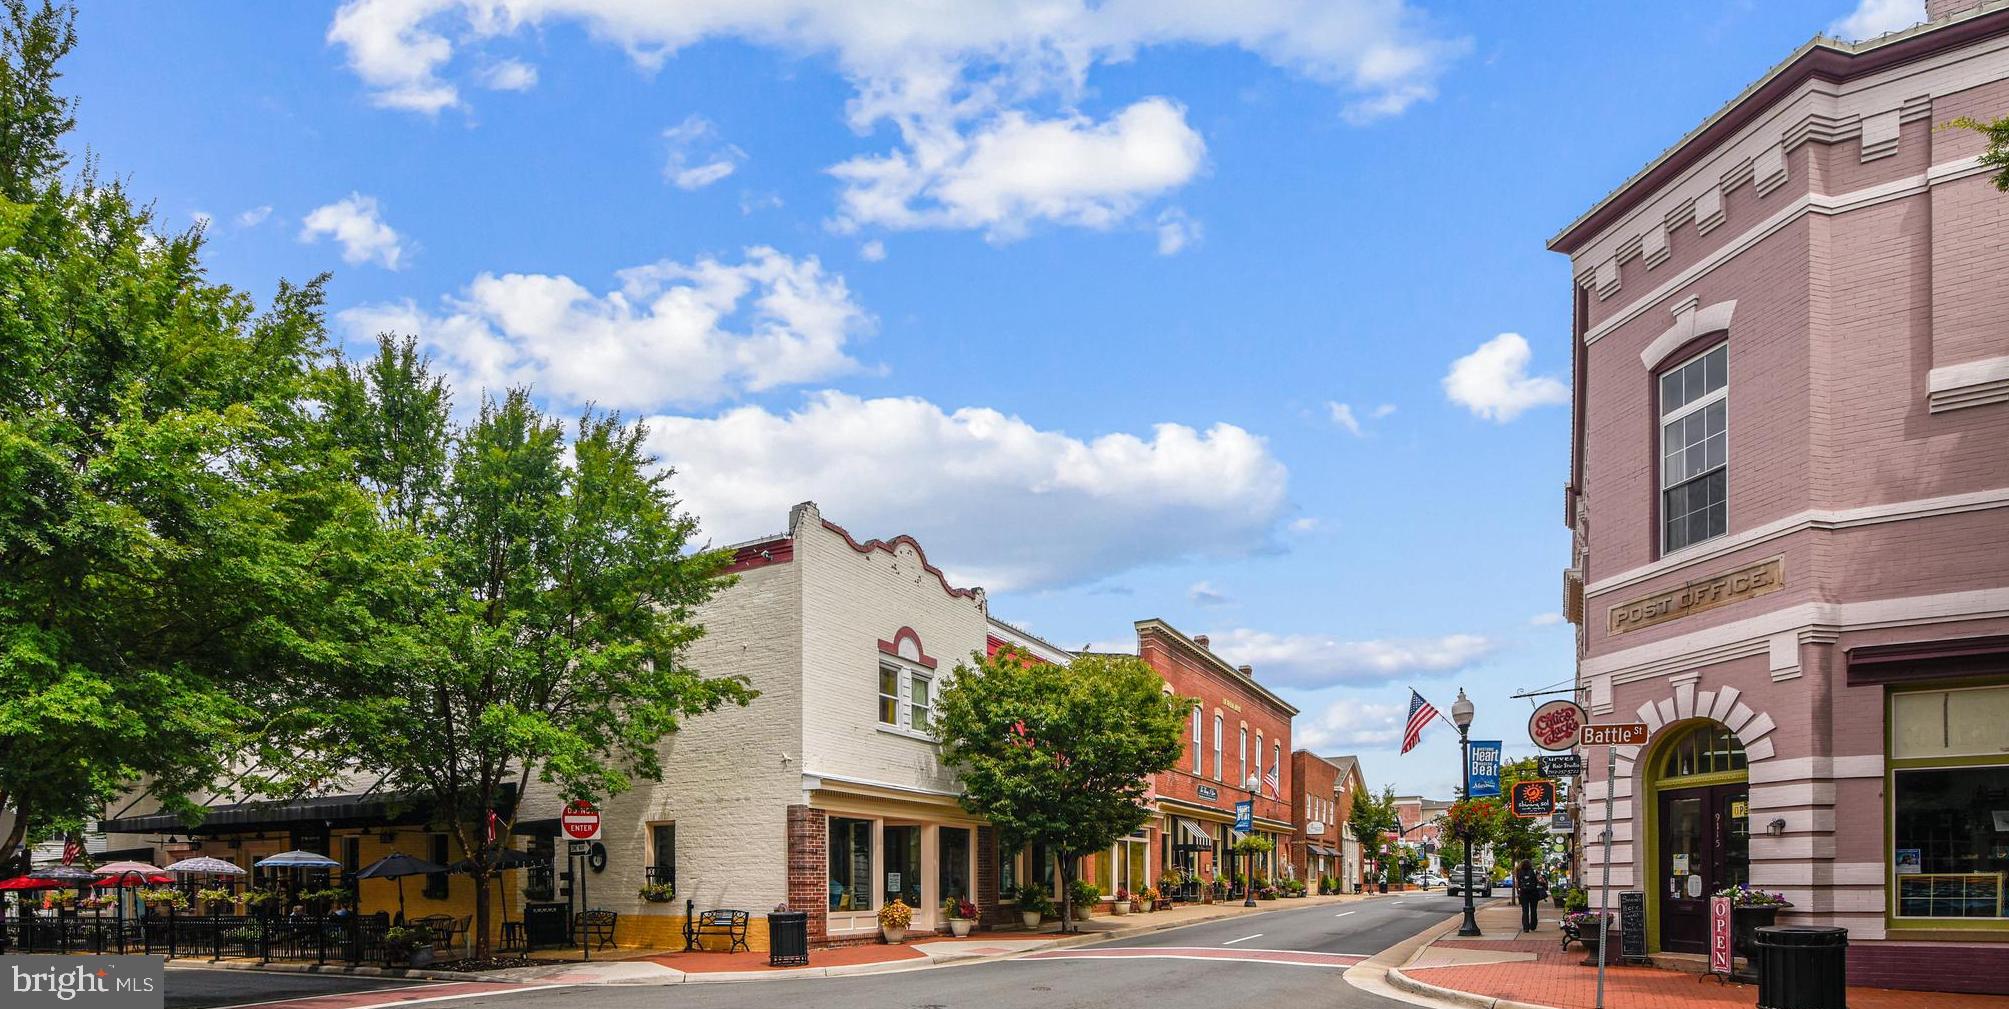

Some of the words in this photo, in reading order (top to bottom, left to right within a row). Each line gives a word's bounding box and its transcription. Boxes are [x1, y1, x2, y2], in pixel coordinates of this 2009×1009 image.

[1616, 597, 1673, 627] POST
[1584, 728, 1632, 744] Battle
[1633, 726, 1643, 735] St
[1472, 747, 1499, 762] Heart
[1472, 761, 1498, 776] Beat
[1540, 799, 1550, 807] sol
[1715, 903, 1726, 965] OPEN
